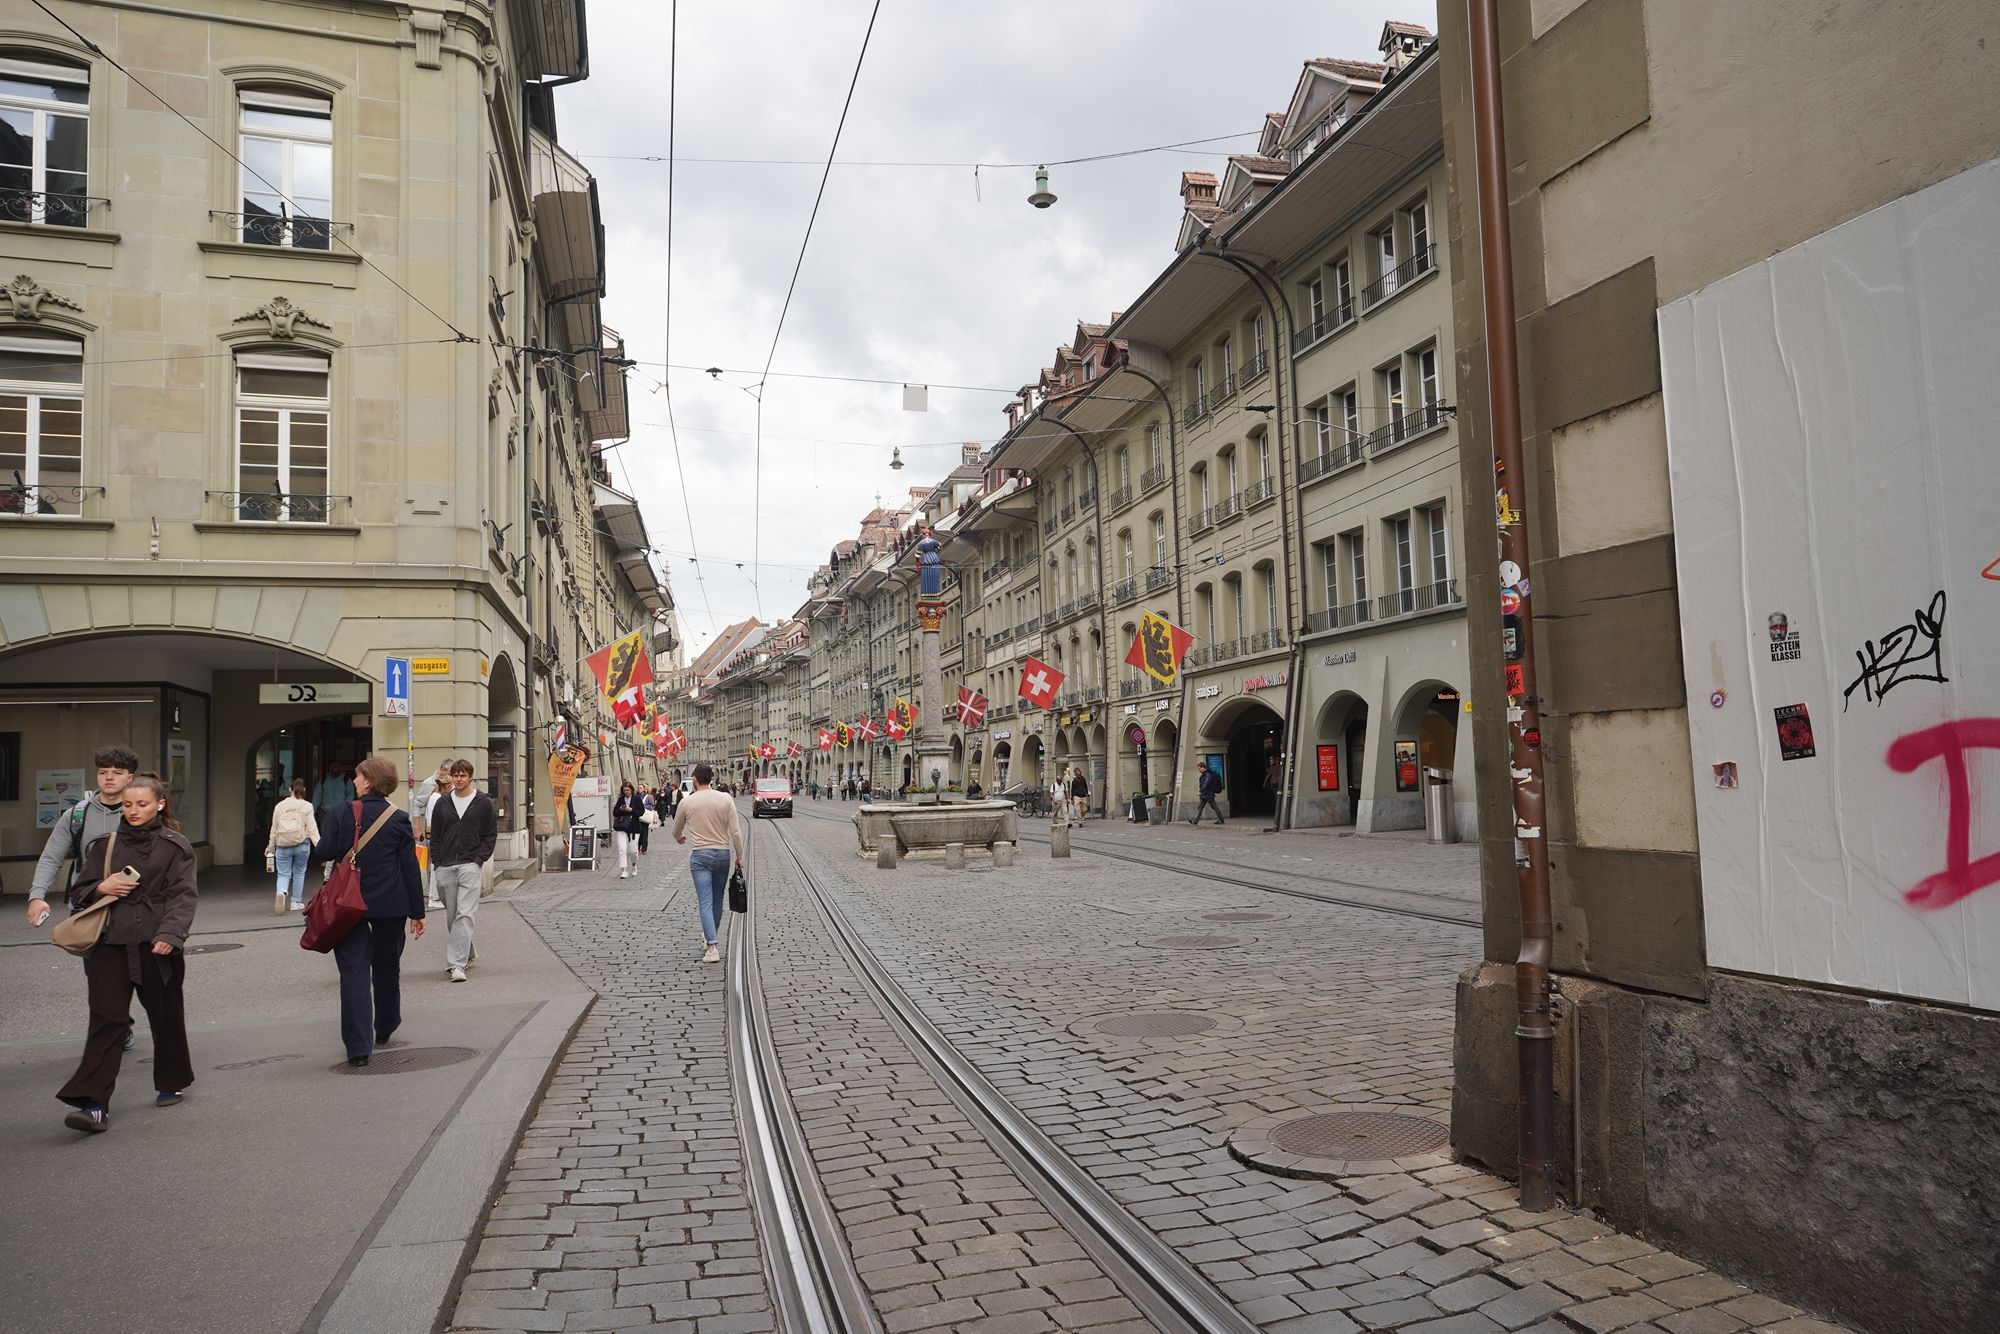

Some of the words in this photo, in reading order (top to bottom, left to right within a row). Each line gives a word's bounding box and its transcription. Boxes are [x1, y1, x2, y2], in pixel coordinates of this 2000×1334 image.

[1770, 640, 1800, 653] EPSTEIN
[1771, 650, 1801, 662] KLASSE!
[288, 685, 317, 702] DQ
[1155, 699, 1169, 711] LUSH
